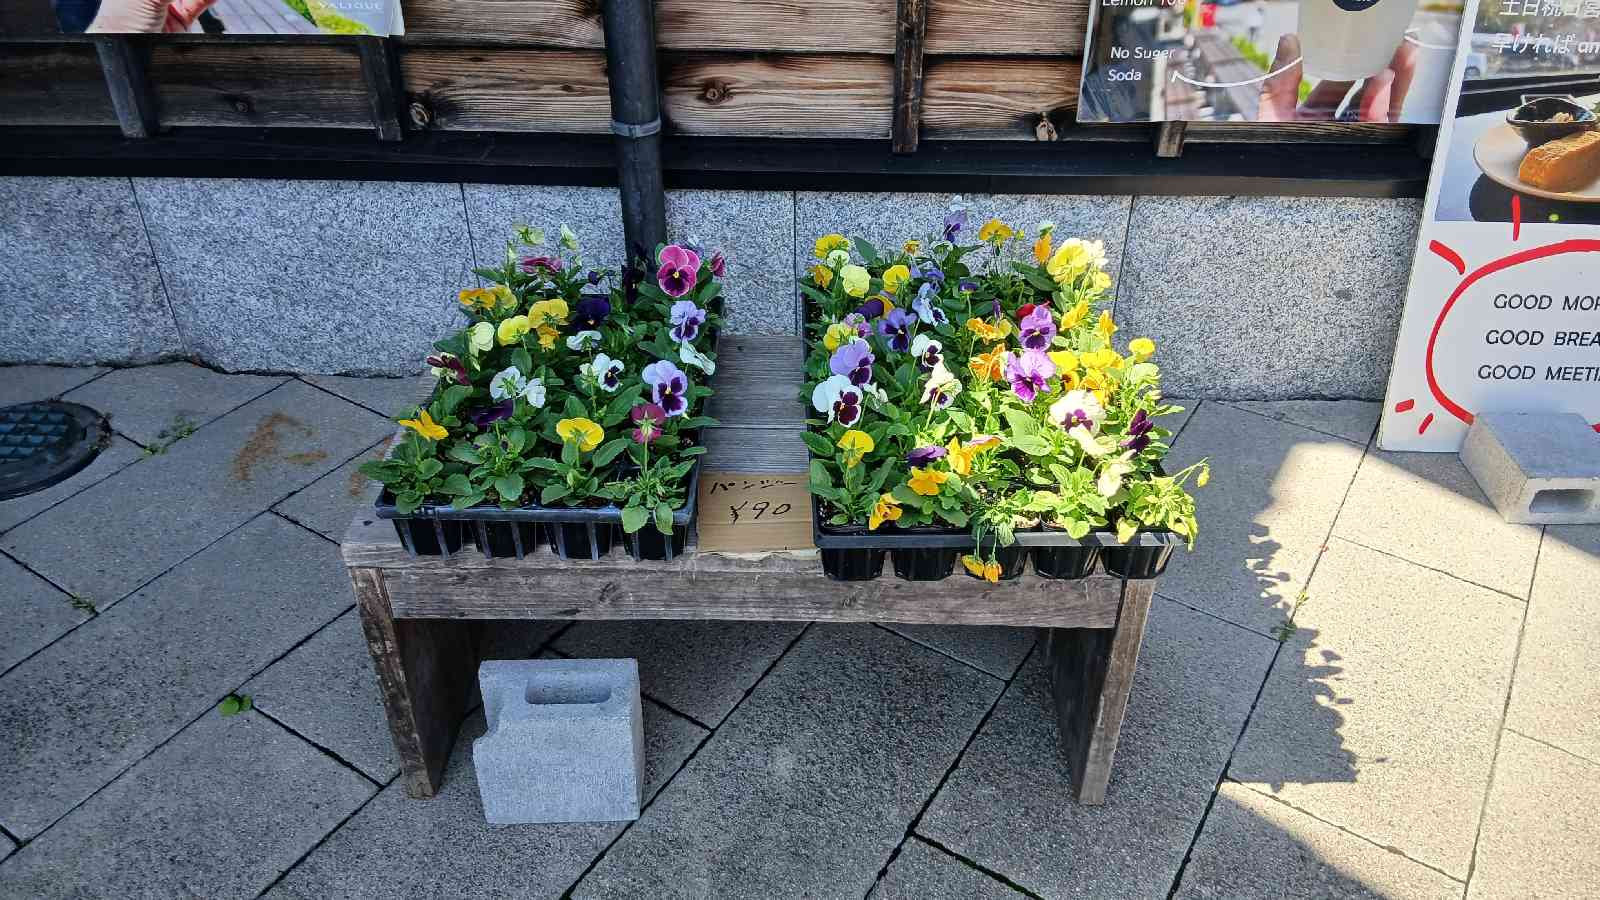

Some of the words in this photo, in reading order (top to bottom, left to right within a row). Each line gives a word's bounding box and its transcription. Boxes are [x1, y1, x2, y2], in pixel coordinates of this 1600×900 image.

[1110, 46, 1130, 59] No
[1133, 46, 1176, 62] Suger
[1107, 68, 1142, 82] Soda
[1493, 293, 1553, 310] GOOD
[1485, 329, 1545, 346] GOOD
[1477, 364, 1536, 380] GOOD
[1545, 365, 1600, 382] MEETI
[728, 500, 792, 526] ¥90
